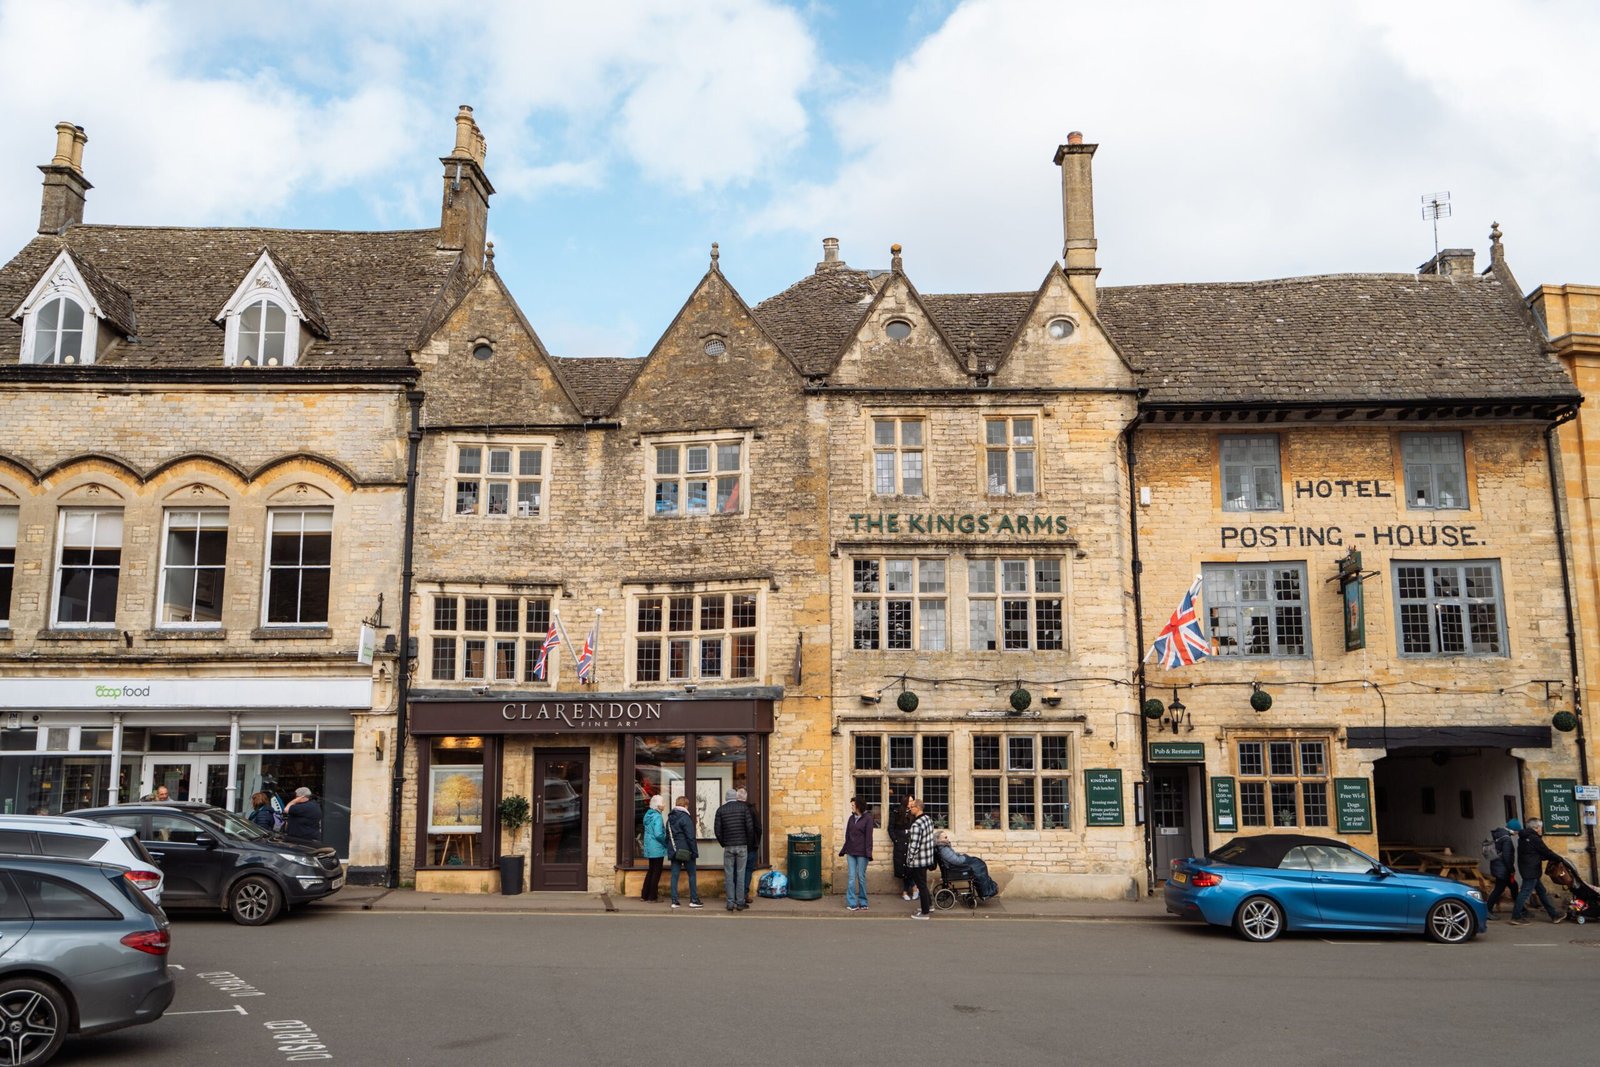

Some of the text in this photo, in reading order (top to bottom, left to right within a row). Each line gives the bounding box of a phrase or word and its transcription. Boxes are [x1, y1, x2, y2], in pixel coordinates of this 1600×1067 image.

[1296, 480, 1391, 498] HOTEL
[849, 513, 1068, 535] THE KINGS ARMS
[1221, 526, 1343, 548] POSTING
[123, 685, 150, 697] food
[502, 702, 663, 728] CLARENDON
[1550, 804, 1570, 812] Drink
[1551, 814, 1570, 822] Sleep
[263, 1019, 334, 1062] DISABLED
